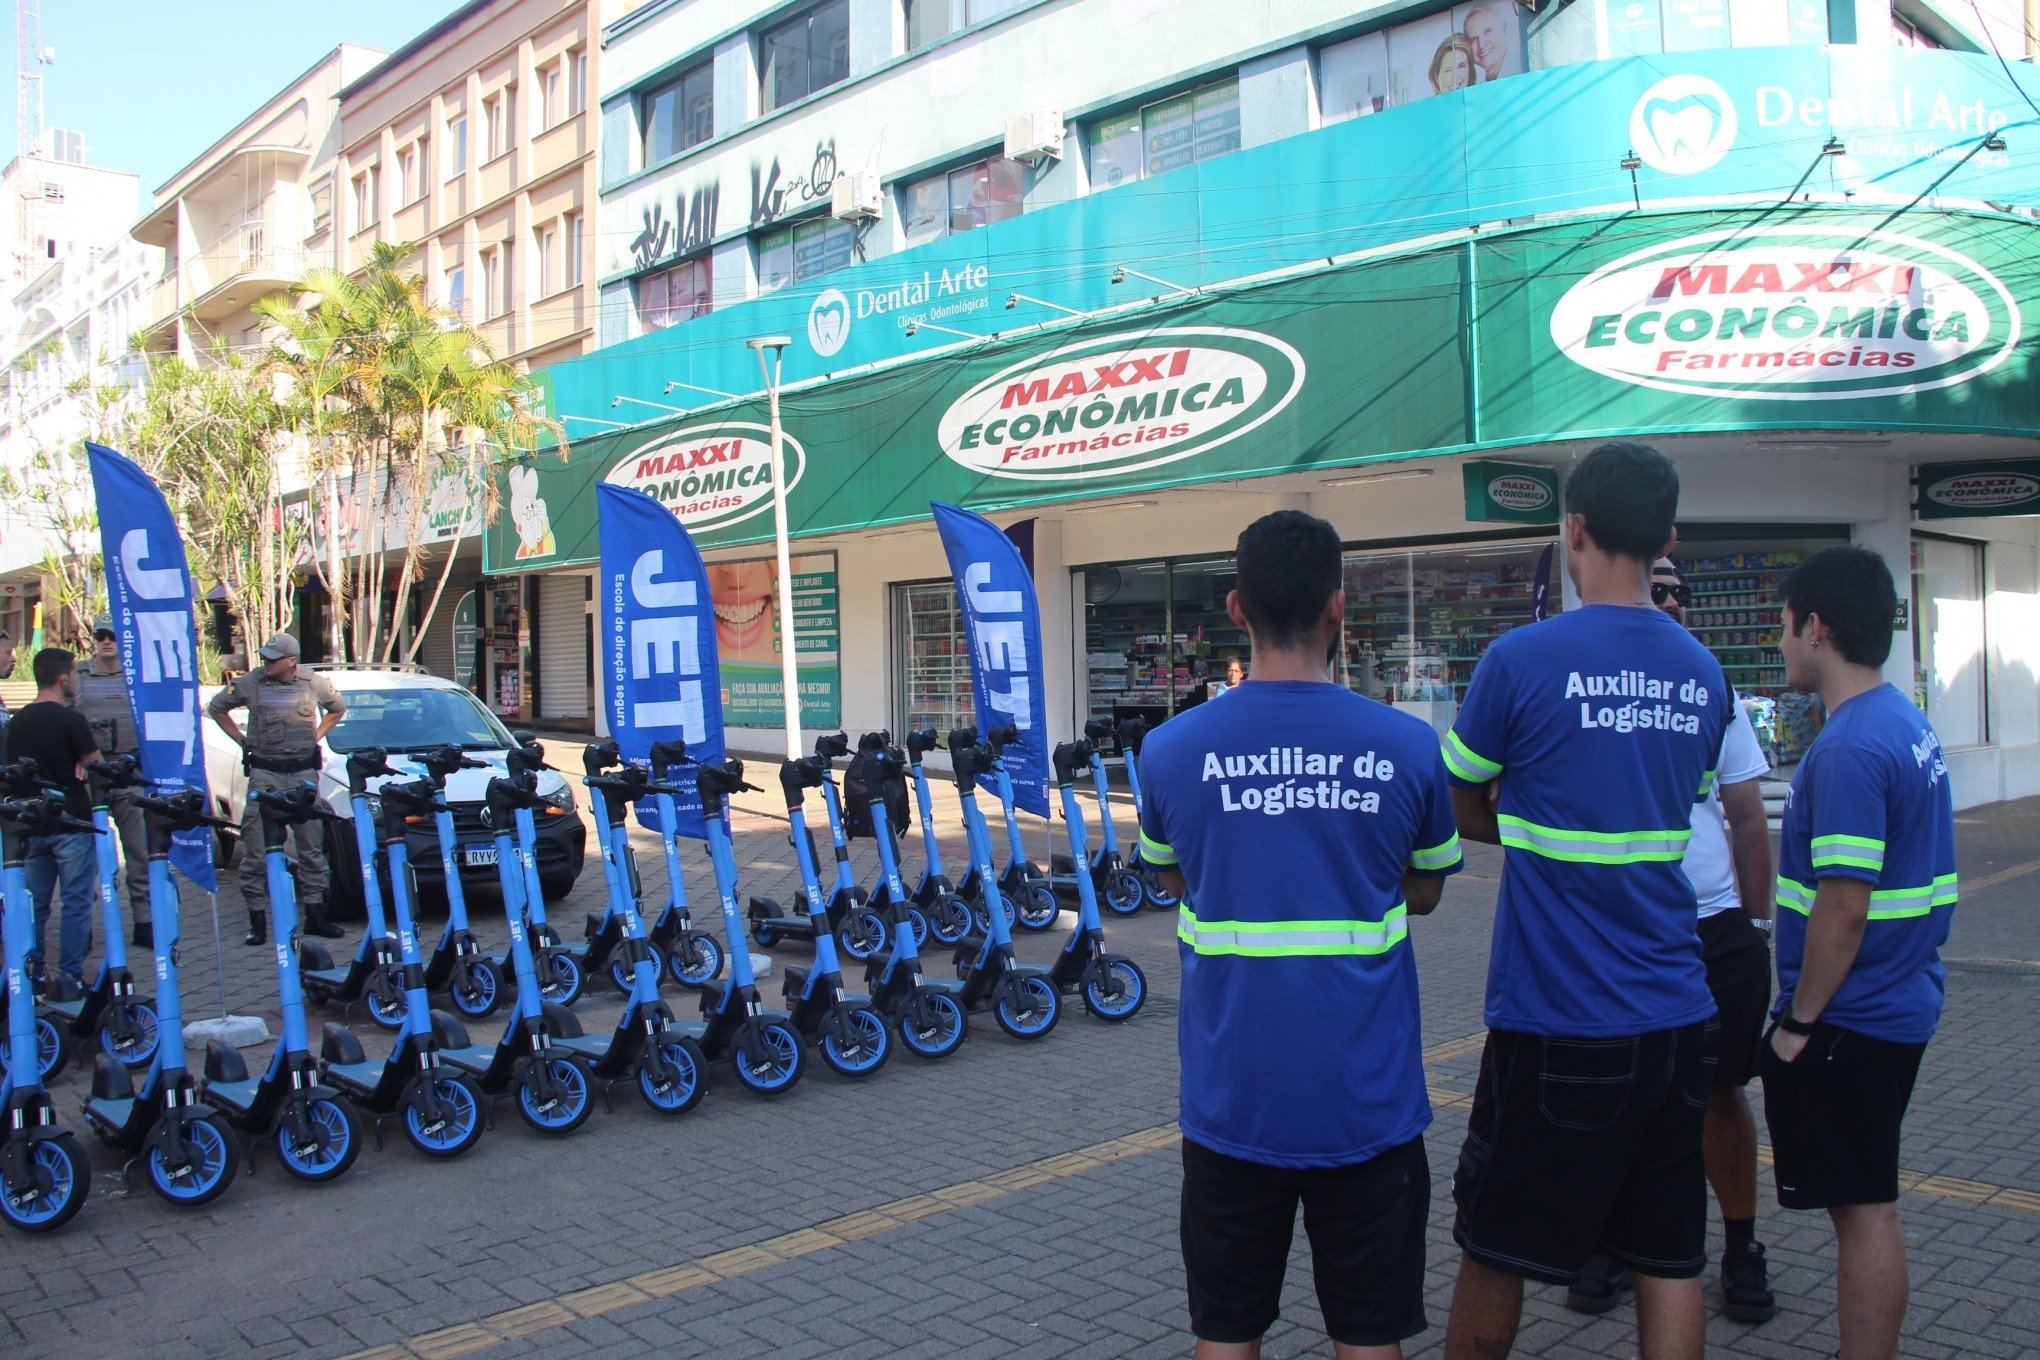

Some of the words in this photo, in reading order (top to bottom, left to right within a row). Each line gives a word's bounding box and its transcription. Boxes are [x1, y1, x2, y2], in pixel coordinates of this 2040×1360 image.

[1755, 86, 1912, 129] Dental
[1926, 90, 2008, 137] Arte
[1162, 130, 1188, 147] IMPLANTE
[1200, 118, 1224, 132] PRÓTESE
[1164, 151, 1190, 168] APARELHO
[1196, 139, 1223, 156] DENTÁRIO
[857, 270, 930, 319] Dental
[938, 262, 988, 297] Arte
[1650, 261, 1916, 298] MAXXI
[897, 311, 927, 329] Clínicas
[930, 296, 988, 320] Odontológicas
[1584, 296, 1971, 349] ECONÔMICA
[1656, 343, 1917, 372] Farmácias
[1000, 349, 1191, 410] MAXXI
[959, 376, 1246, 450] ECONÔMICA
[1001, 421, 1191, 464] Farmácias
[636, 438, 743, 479] MAXXI
[636, 462, 773, 501] ONÔMICA
[1501, 481, 1536, 491] MAXXI
[1951, 478, 2017, 489] MAXXI
[430, 505, 472, 529] LANCHS
[669, 494, 743, 516] mácias
[615, 573, 625, 613] Escola
[121, 607, 134, 626] de
[615, 616, 626, 632] de
[120, 528, 195, 767] JET
[122, 629, 137, 685] direção
[613, 635, 627, 682] direção
[630, 549, 707, 745] JET
[965, 561, 1032, 730] JET
[732, 682, 746, 697] FAÇA
[746, 682, 757, 695] SUA
[758, 681, 784, 697] AVALIAÇÃ
[807, 682, 831, 695] MESMO!
[980, 672, 990, 707] segura
[1565, 669, 1674, 699] Auxiliar
[1679, 678, 1709, 707] de
[615, 685, 627, 727] segura
[1581, 700, 1700, 735] Logística
[1911, 728, 1939, 769] Auxilia
[1202, 747, 1344, 782] Auxiliar
[1353, 750, 1395, 782] de
[1220, 778, 1381, 816] Logística
[921, 816, 930, 831] JET
[1005, 808, 1014, 822] JET
[832, 825, 842, 840] JET
[523, 852, 533, 869] JET
[602, 845, 611, 861] JET
[665, 840, 674, 855] JET
[363, 863, 371, 881] JET
[443, 857, 451, 874] JET
[981, 863, 992, 883] JET
[1076, 854, 1086, 871] JET
[102, 883, 112, 903] JET
[808, 885, 820, 905] JET
[888, 873, 900, 894] JET
[722, 896, 734, 917] JET
[510, 920, 522, 942] JET
[625, 909, 636, 931] JET
[401, 929, 412, 954] JET
[156, 955, 168, 980] JET
[277, 943, 289, 968] JET
[8, 968, 21, 995] JET
